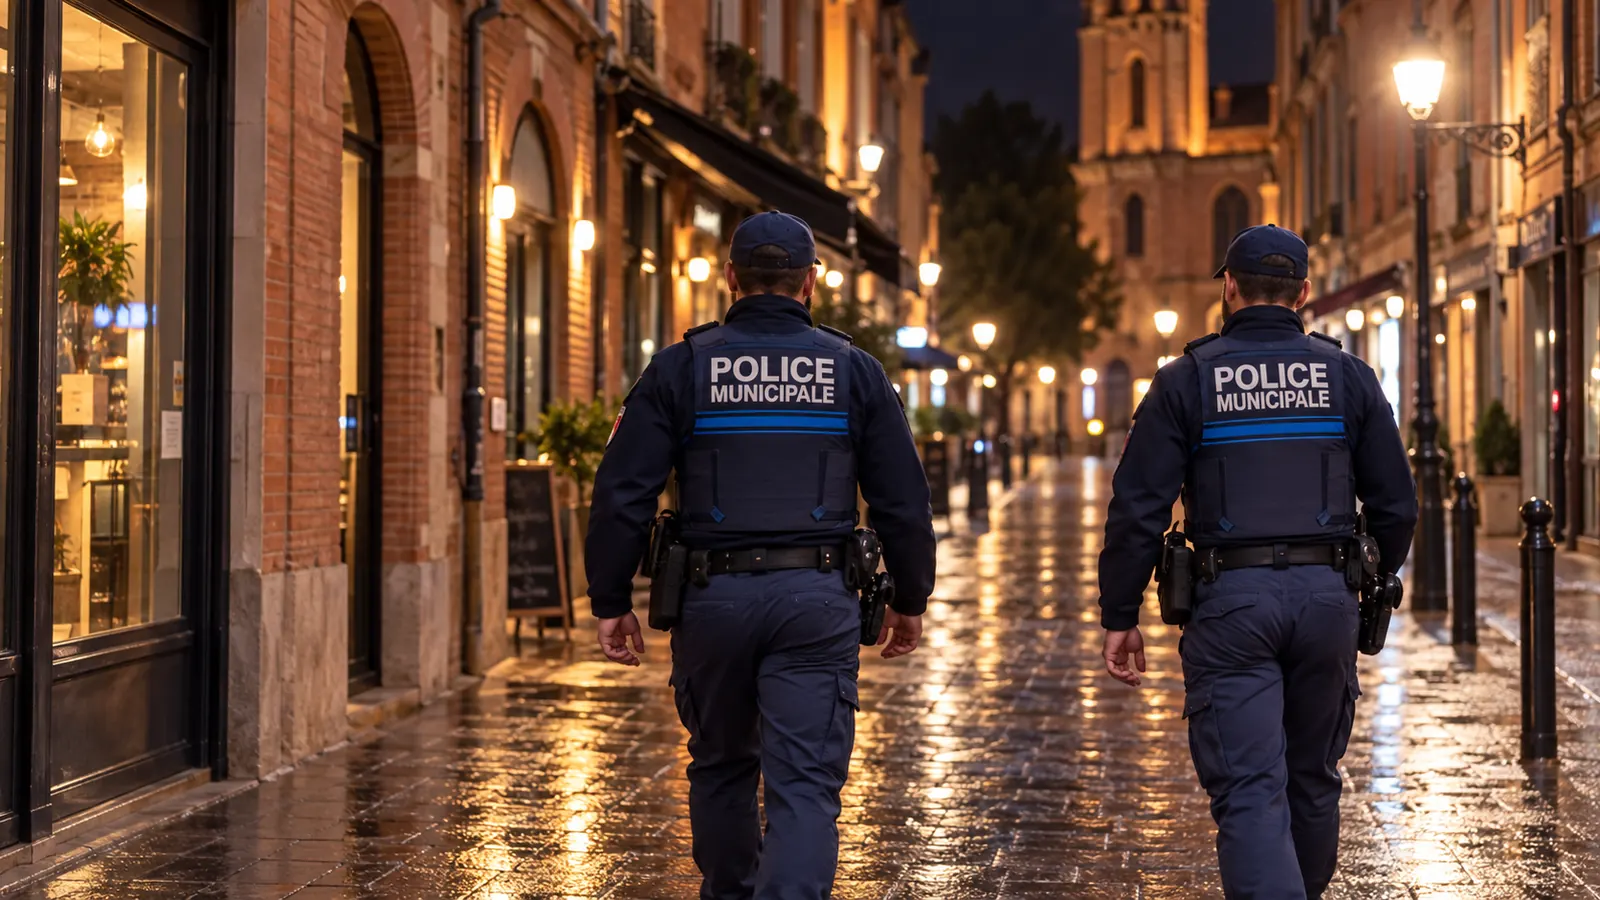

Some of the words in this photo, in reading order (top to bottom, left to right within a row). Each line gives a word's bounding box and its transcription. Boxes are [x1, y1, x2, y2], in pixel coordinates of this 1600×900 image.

[710, 355, 835, 385] POLICE
[1214, 362, 1329, 393] POLICE
[710, 384, 835, 404] MUNICIPALE
[1216, 389, 1331, 413] MUNICIPALE
